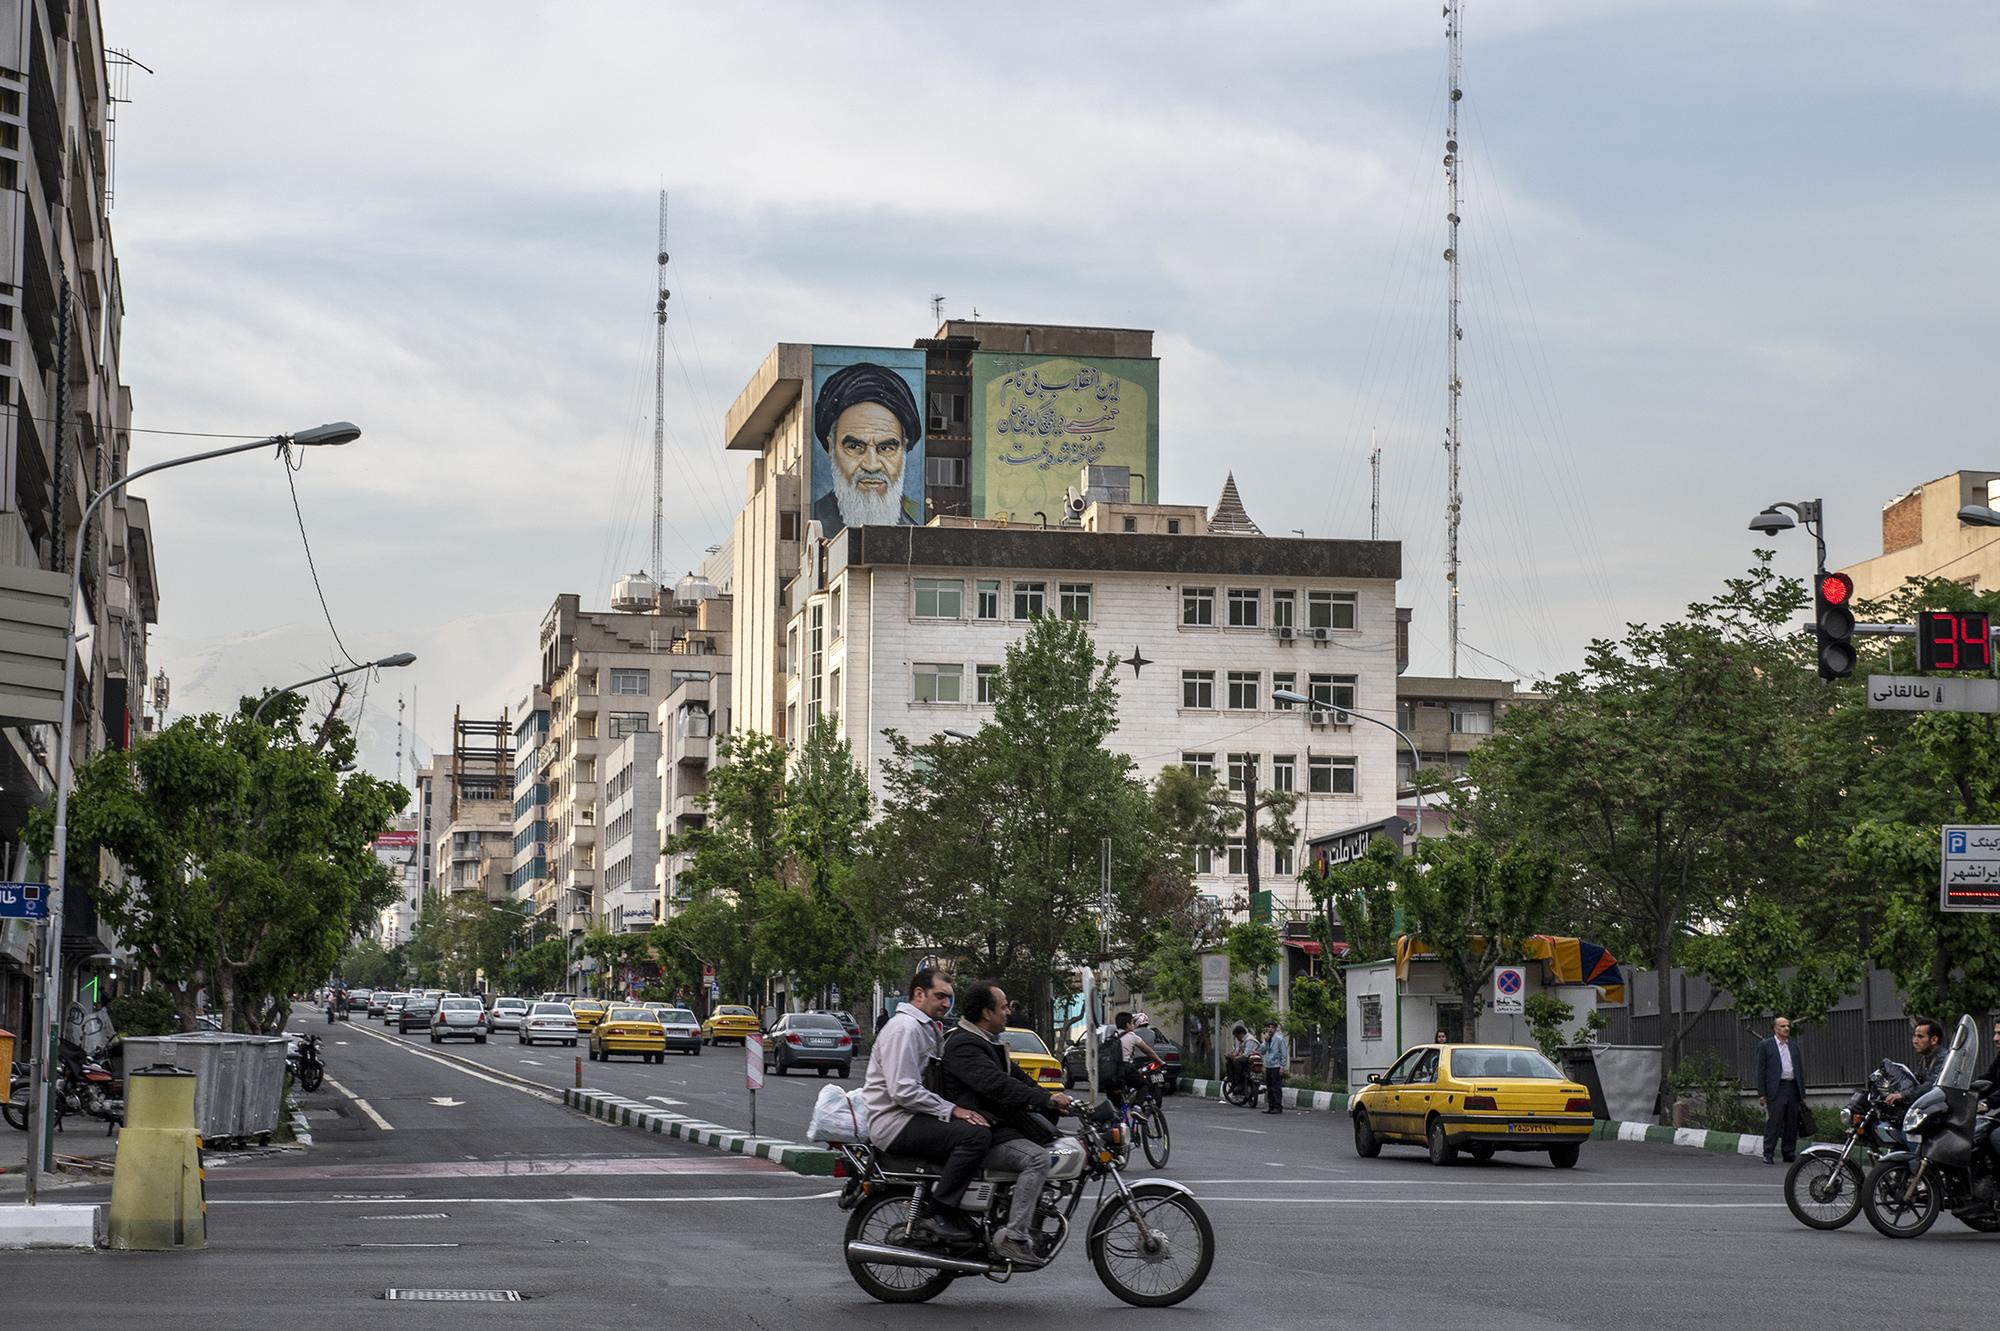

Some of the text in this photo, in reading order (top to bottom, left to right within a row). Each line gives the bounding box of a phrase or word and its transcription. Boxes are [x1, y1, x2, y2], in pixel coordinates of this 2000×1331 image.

[1001, 371, 1027, 407] نام
[1040, 367, 1101, 398] انقلاب
[1096, 376, 1120, 403] این
[1063, 405, 1120, 441] خمینی
[1932, 614, 1989, 668] 34
[1873, 685, 1930, 702] طالقانی
[1329, 831, 1371, 865] انک ملت
